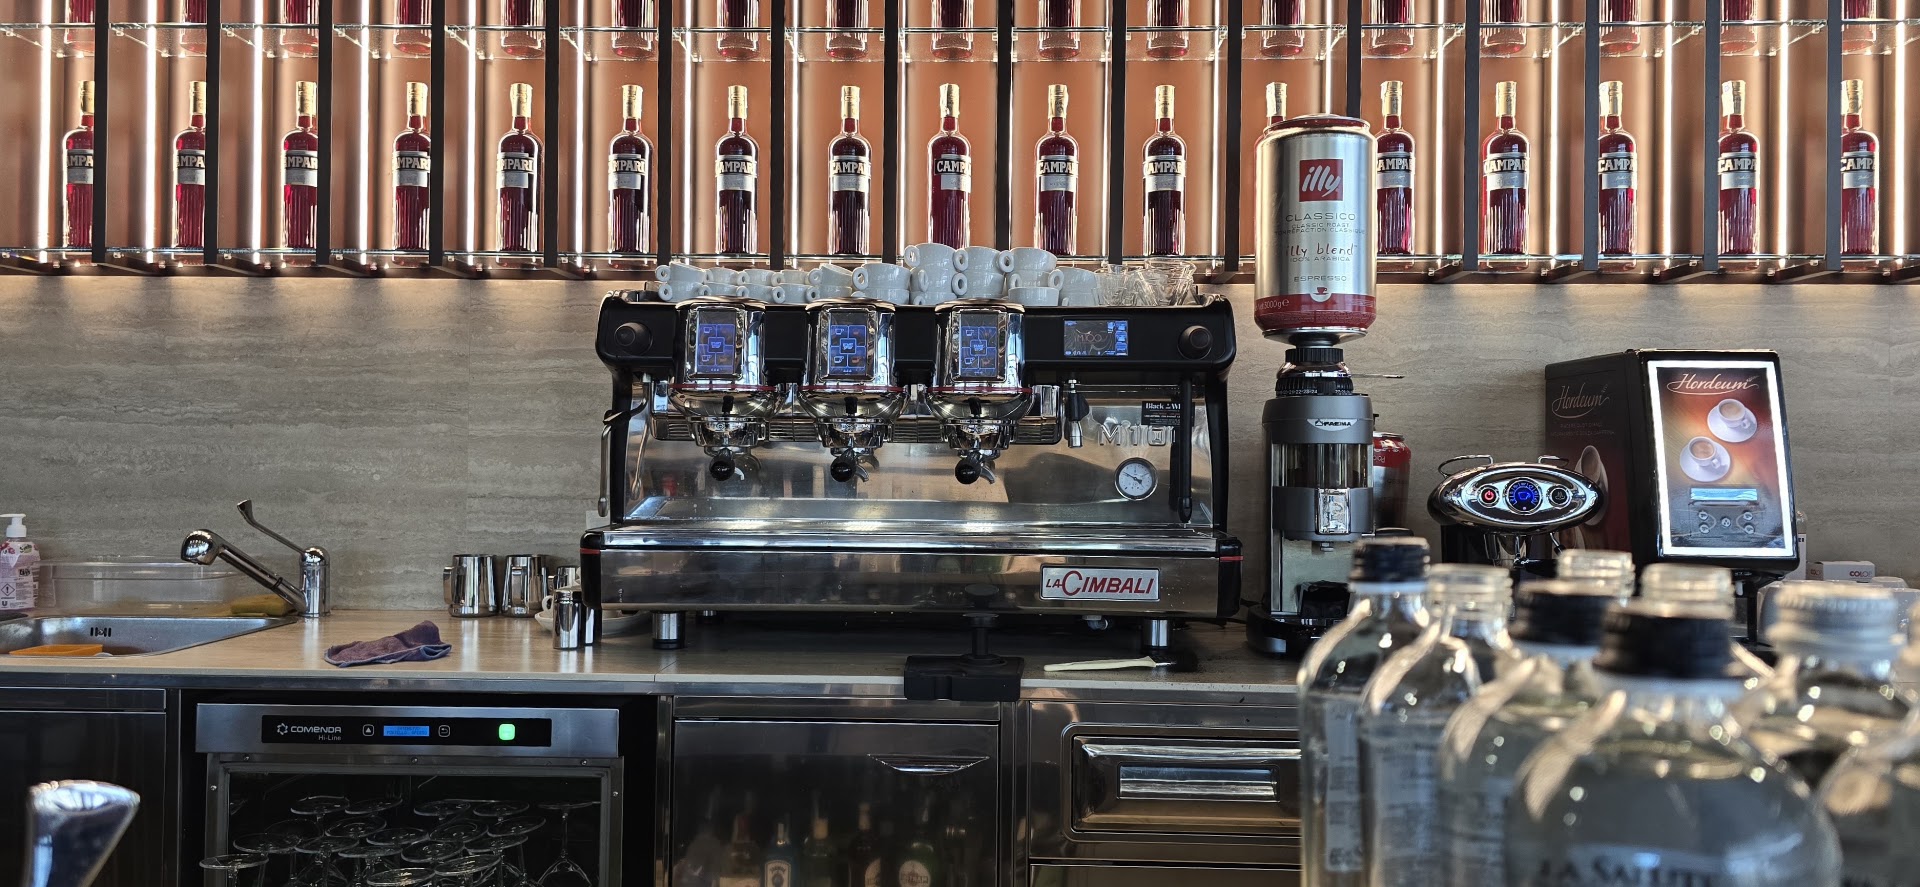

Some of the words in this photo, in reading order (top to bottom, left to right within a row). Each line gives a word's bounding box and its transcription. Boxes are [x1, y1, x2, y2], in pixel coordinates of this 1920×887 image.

[1302, 165, 1341, 198] illy
[1286, 212, 1357, 222] CLASSICO
[1292, 222, 1324, 230] CLASSIC
[1286, 244, 1308, 257] illy
[1668, 373, 1753, 393] Hordeum
[1553, 382, 1606, 414] Hordeum
[1145, 402, 1164, 410] Black
[1062, 570, 1155, 597] CIMBALI
[290, 725, 342, 733] COMENDA
